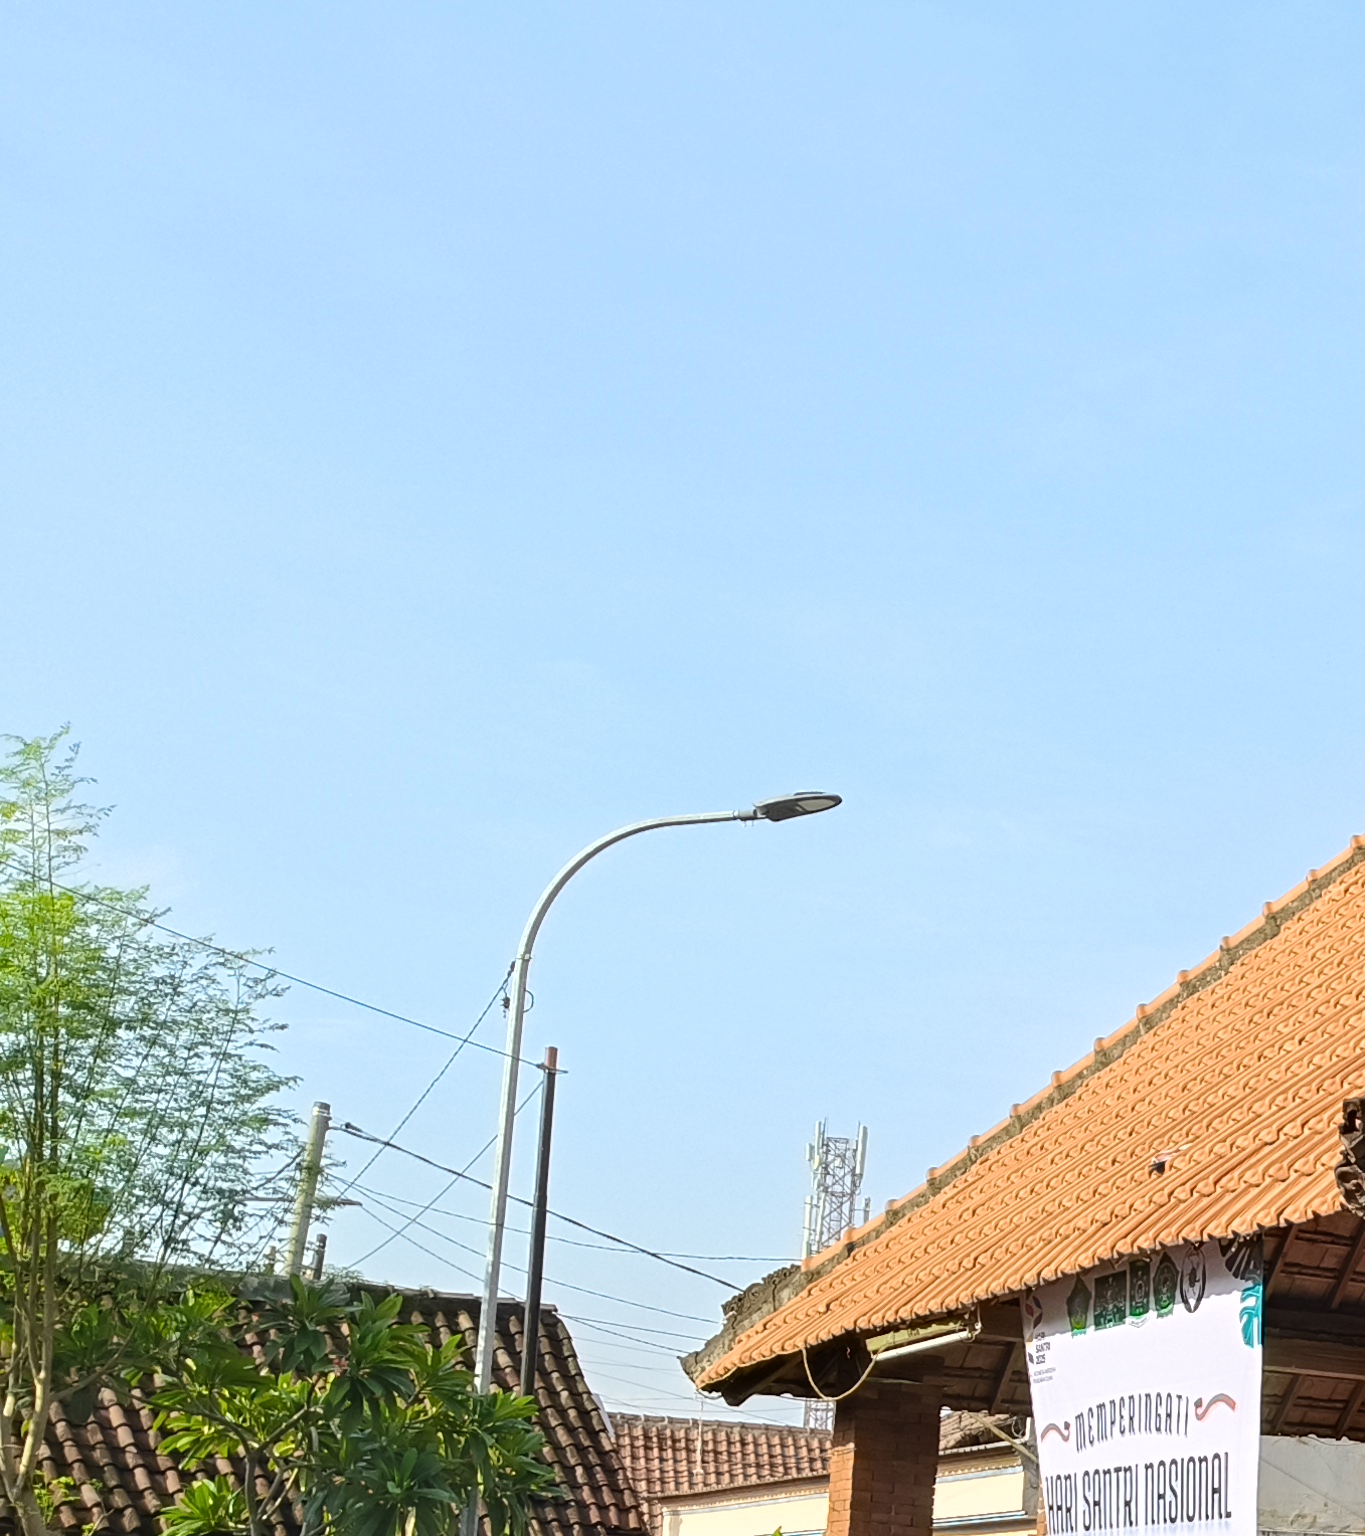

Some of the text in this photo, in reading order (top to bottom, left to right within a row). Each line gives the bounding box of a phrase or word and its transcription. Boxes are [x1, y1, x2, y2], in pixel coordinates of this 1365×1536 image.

[1074, 1391, 1189, 1453] MEMPERINGATI
[1045, 1451, 1232, 1535] HARI SANTRI NASIONAL
